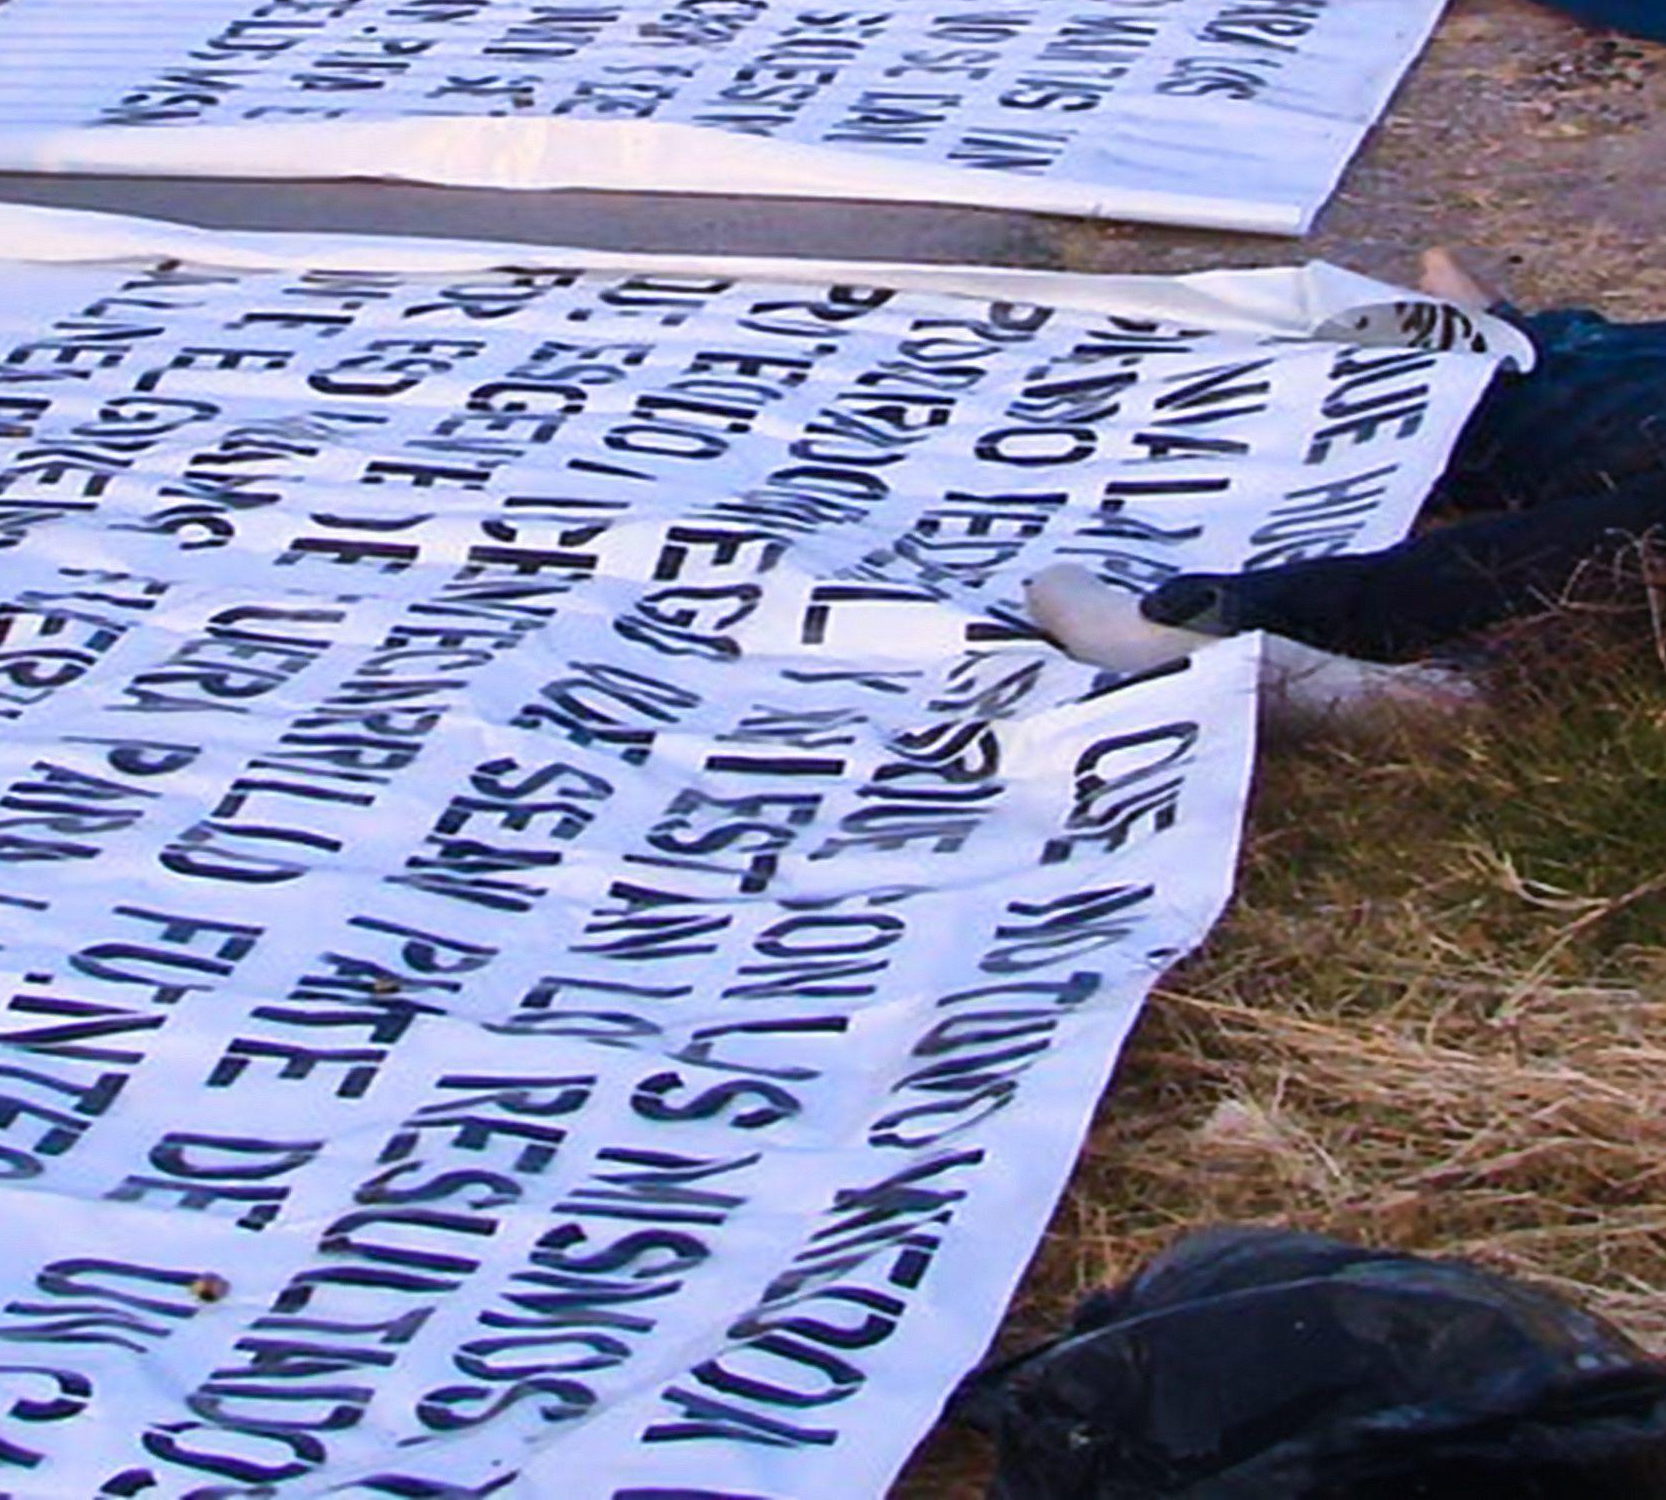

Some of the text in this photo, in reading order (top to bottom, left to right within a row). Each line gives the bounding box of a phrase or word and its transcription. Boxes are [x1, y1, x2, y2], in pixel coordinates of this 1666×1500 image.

[109, 595, 360, 713] UERA
[384, 758, 645, 912] SEAN
[1040, 722, 1198, 865] QUE
[569, 789, 823, 960] ESTAN
[979, 885, 1154, 978] NO
[482, 977, 692, 1048] LO
[104, 1133, 323, 1231] DE
[100, 1076, 596, 1500] RESULTADOS
[406, 1148, 761, 1440] MISMOS
